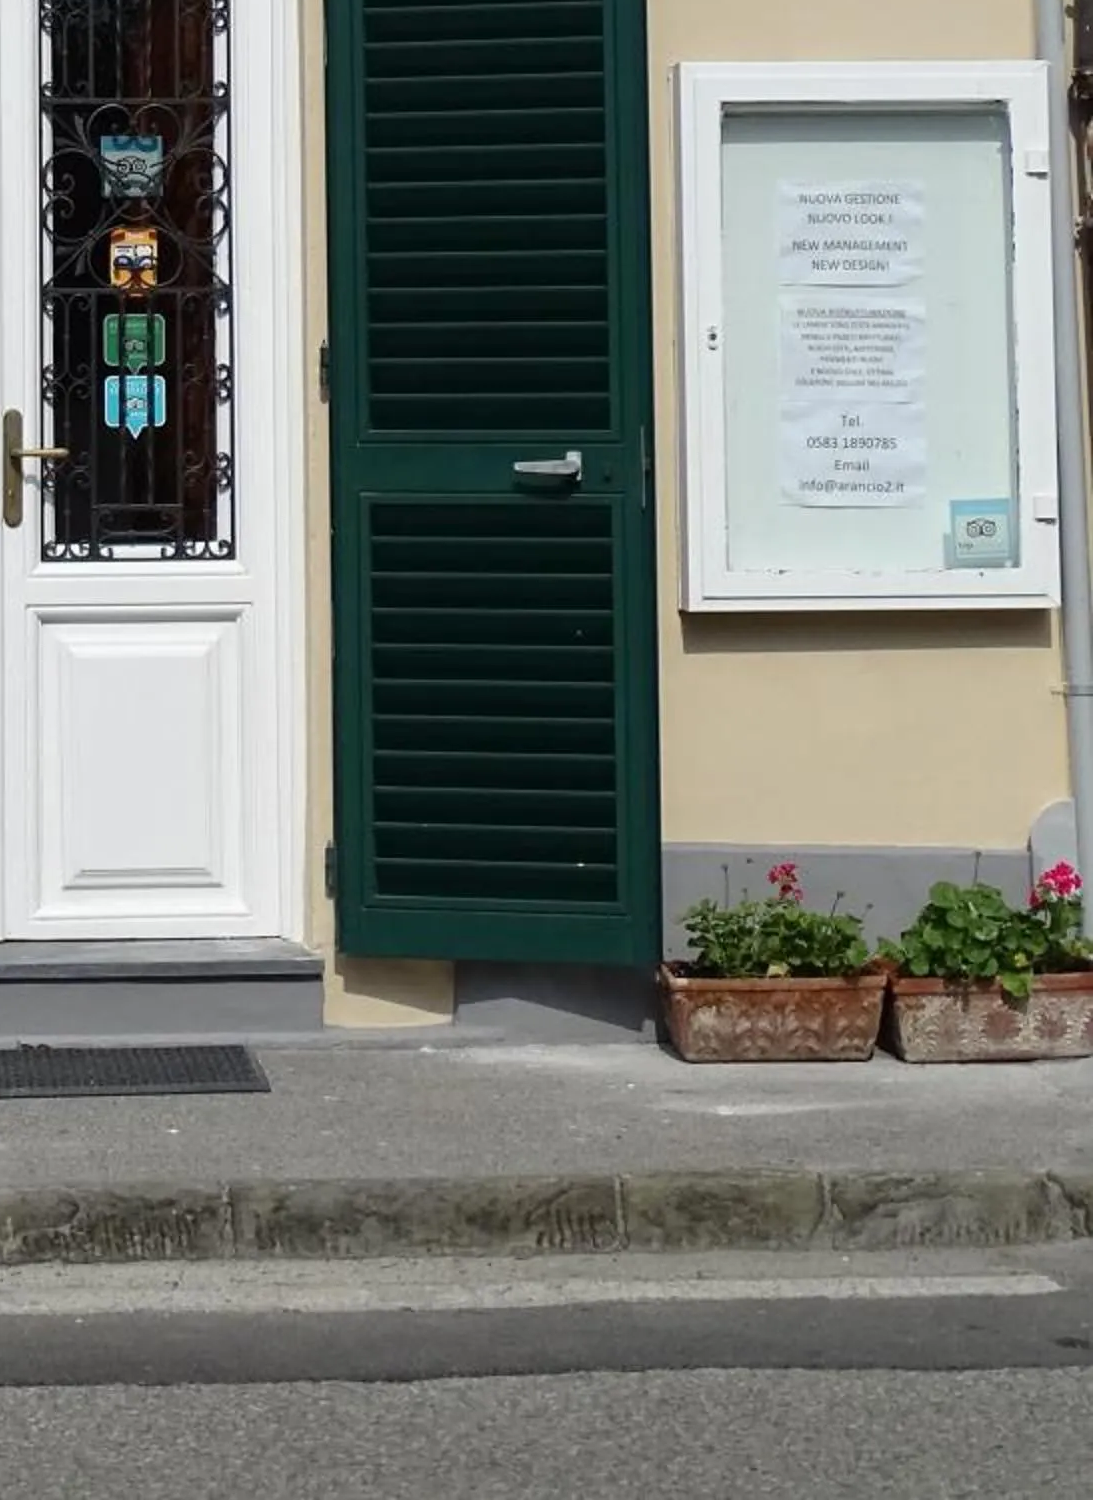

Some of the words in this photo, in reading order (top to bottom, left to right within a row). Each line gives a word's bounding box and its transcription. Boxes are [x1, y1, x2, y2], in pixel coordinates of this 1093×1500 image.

[798, 193, 842, 205] NUOVA
[845, 193, 901, 205] GESTIONE
[808, 213, 851, 225] NUOVO
[792, 239, 819, 251] NEW
[823, 239, 908, 251] MANAGEMENT
[811, 259, 839, 271] NEW
[807, 437, 838, 449] 0583
[842, 437, 898, 449] 1890785
[834, 459, 870, 471] Email
[799, 479, 905, 493] info@arancio2.it
